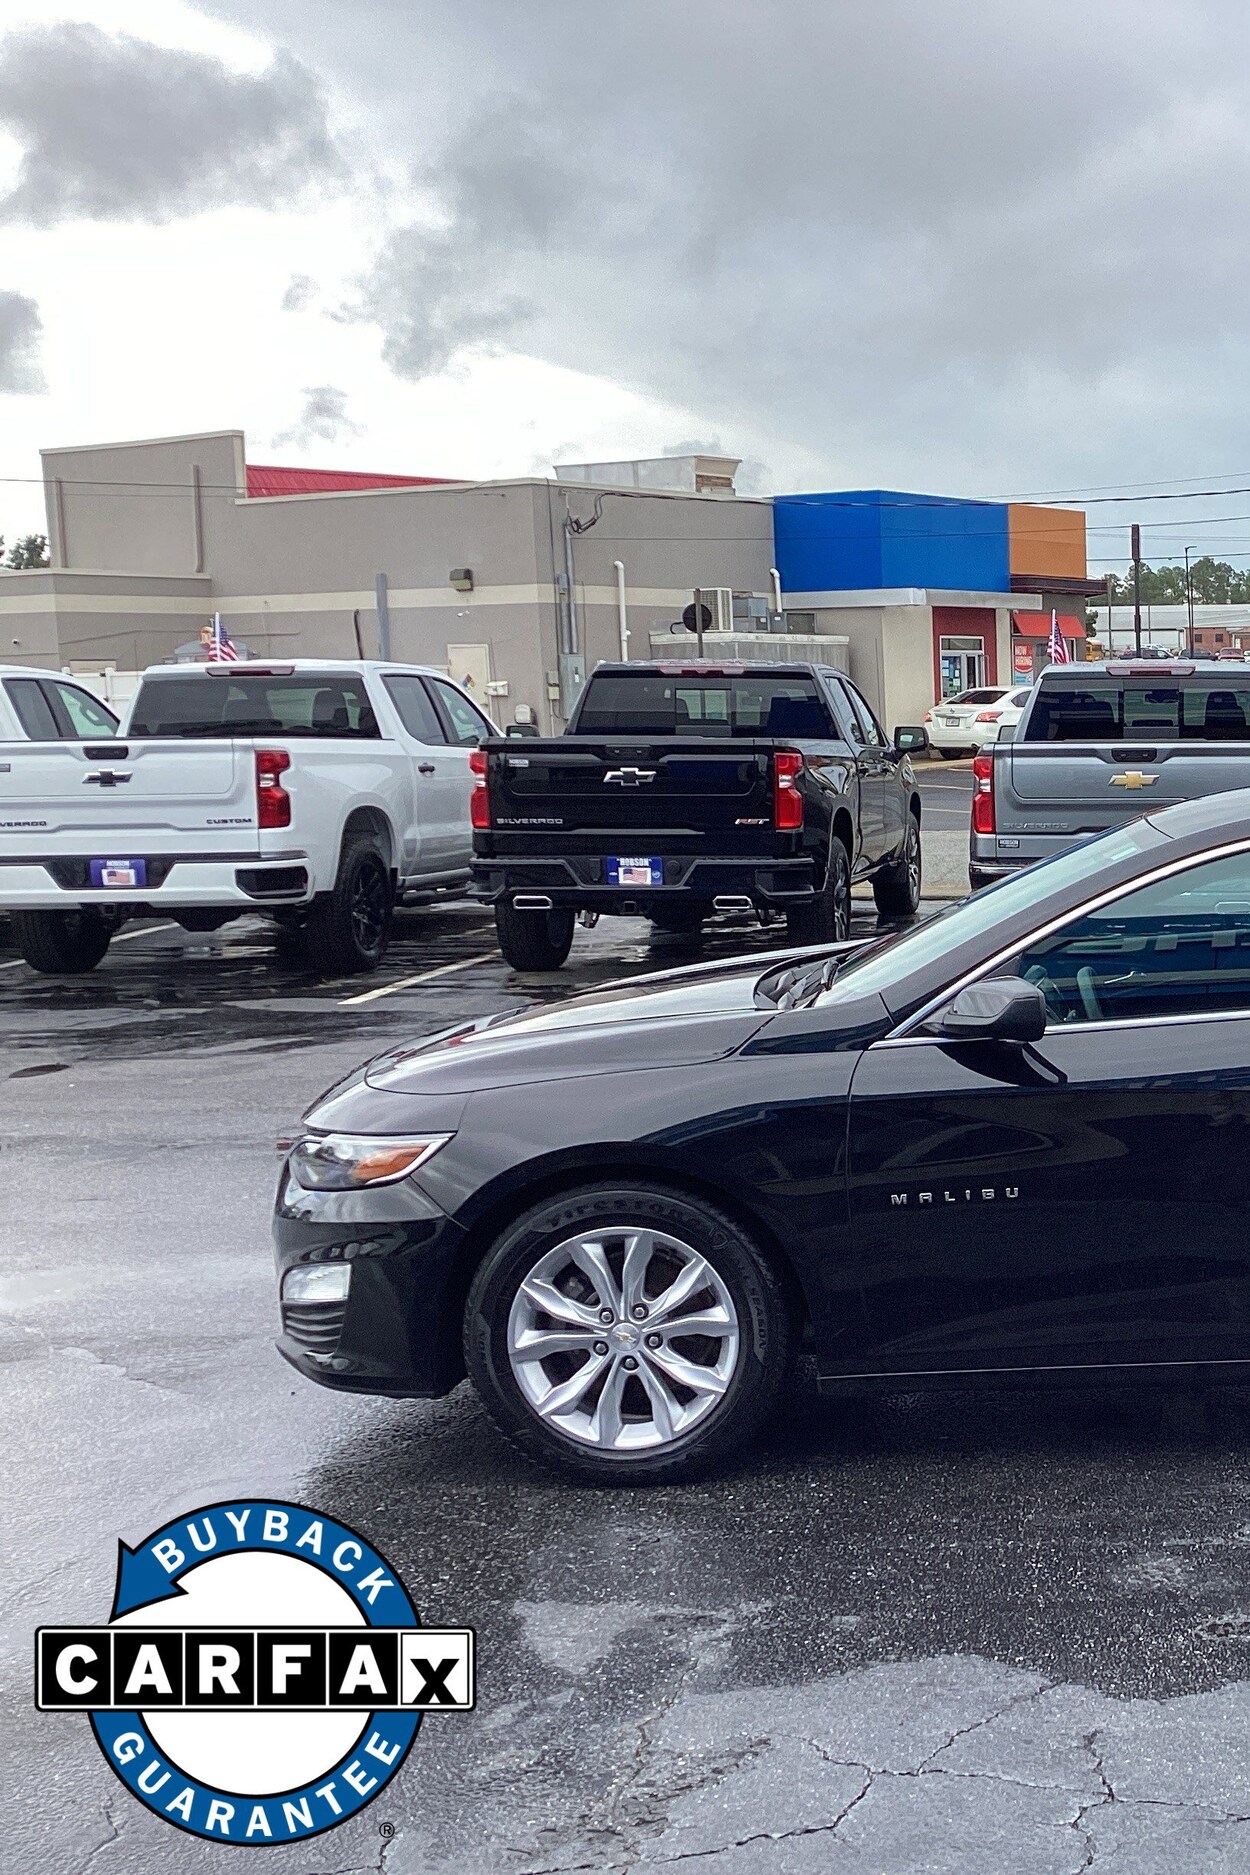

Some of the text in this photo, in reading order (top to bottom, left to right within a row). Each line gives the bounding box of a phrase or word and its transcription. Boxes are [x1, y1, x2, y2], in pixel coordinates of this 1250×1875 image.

[1014, 645, 1027, 656] NOW
[1014, 655, 1033, 667] HIRING
[619, 857, 649, 867] HOBSON
[890, 1187, 1019, 1205] MALIBU
